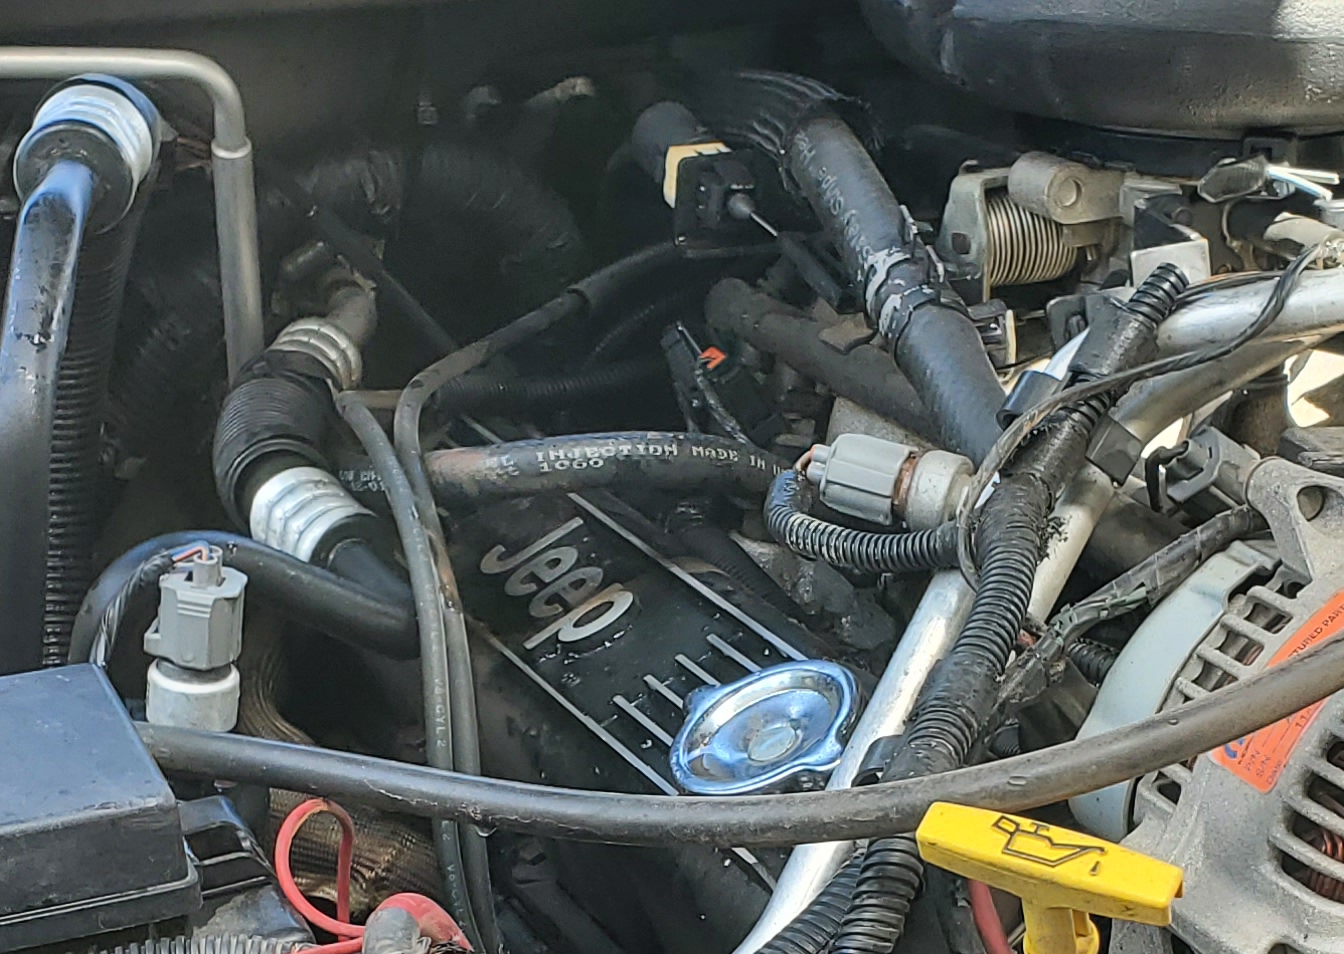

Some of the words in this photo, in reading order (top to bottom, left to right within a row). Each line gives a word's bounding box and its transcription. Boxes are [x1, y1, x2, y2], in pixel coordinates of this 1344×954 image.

[536, 444, 678, 462] INJECTION
[692, 445, 738, 462] MADE
[480, 517, 634, 649] Jeep
